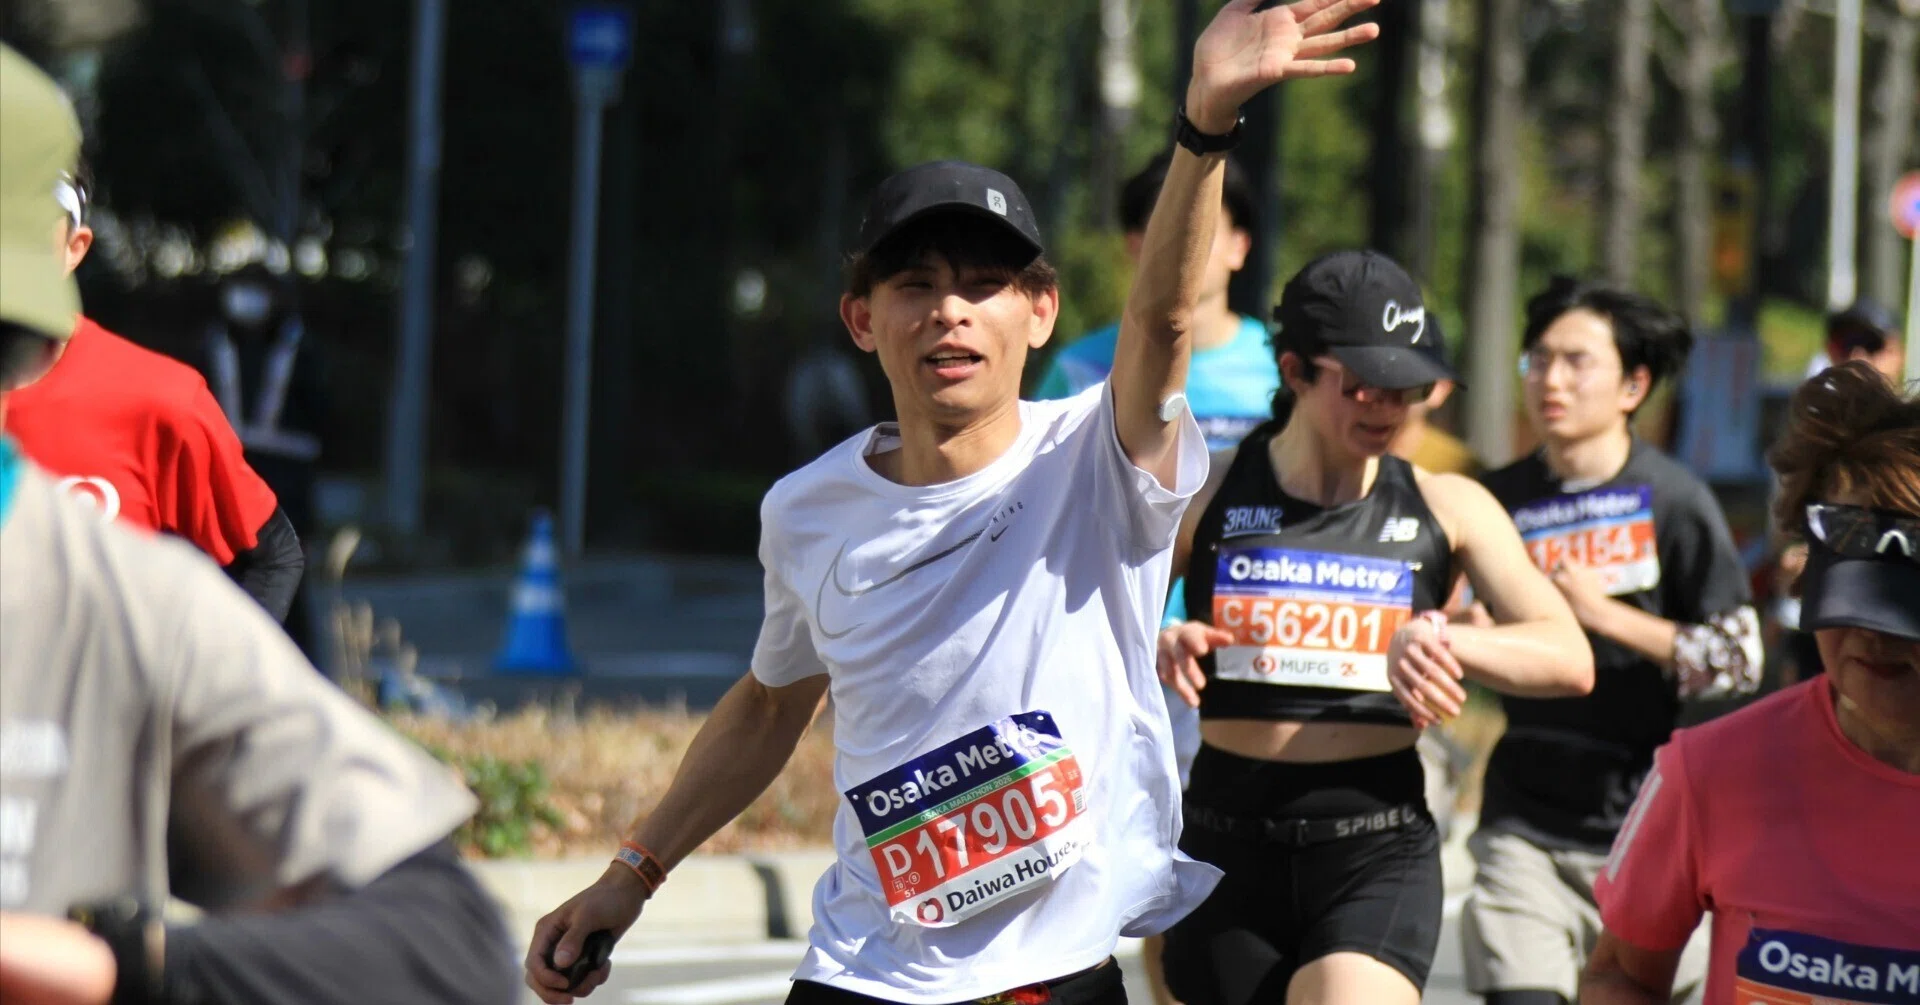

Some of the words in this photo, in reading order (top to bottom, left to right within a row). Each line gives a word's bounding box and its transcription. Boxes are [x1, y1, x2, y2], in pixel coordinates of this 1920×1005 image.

[1229, 555, 1313, 584] Osaka
[1316, 561, 1400, 592] Metro
[1222, 599, 1244, 627] C
[1250, 600, 1382, 651] 56201
[1280, 658, 1330, 676] MUFG
[868, 764, 958, 818] Osaka
[920, 804, 949, 822] OSAKA
[949, 783, 993, 809] MARATHON
[882, 843, 912, 878] D
[915, 771, 1068, 879] 17905
[946, 872, 1016, 912] Daiwa
[1014, 841, 1071, 882] House
[1758, 940, 1879, 991] Osaka
